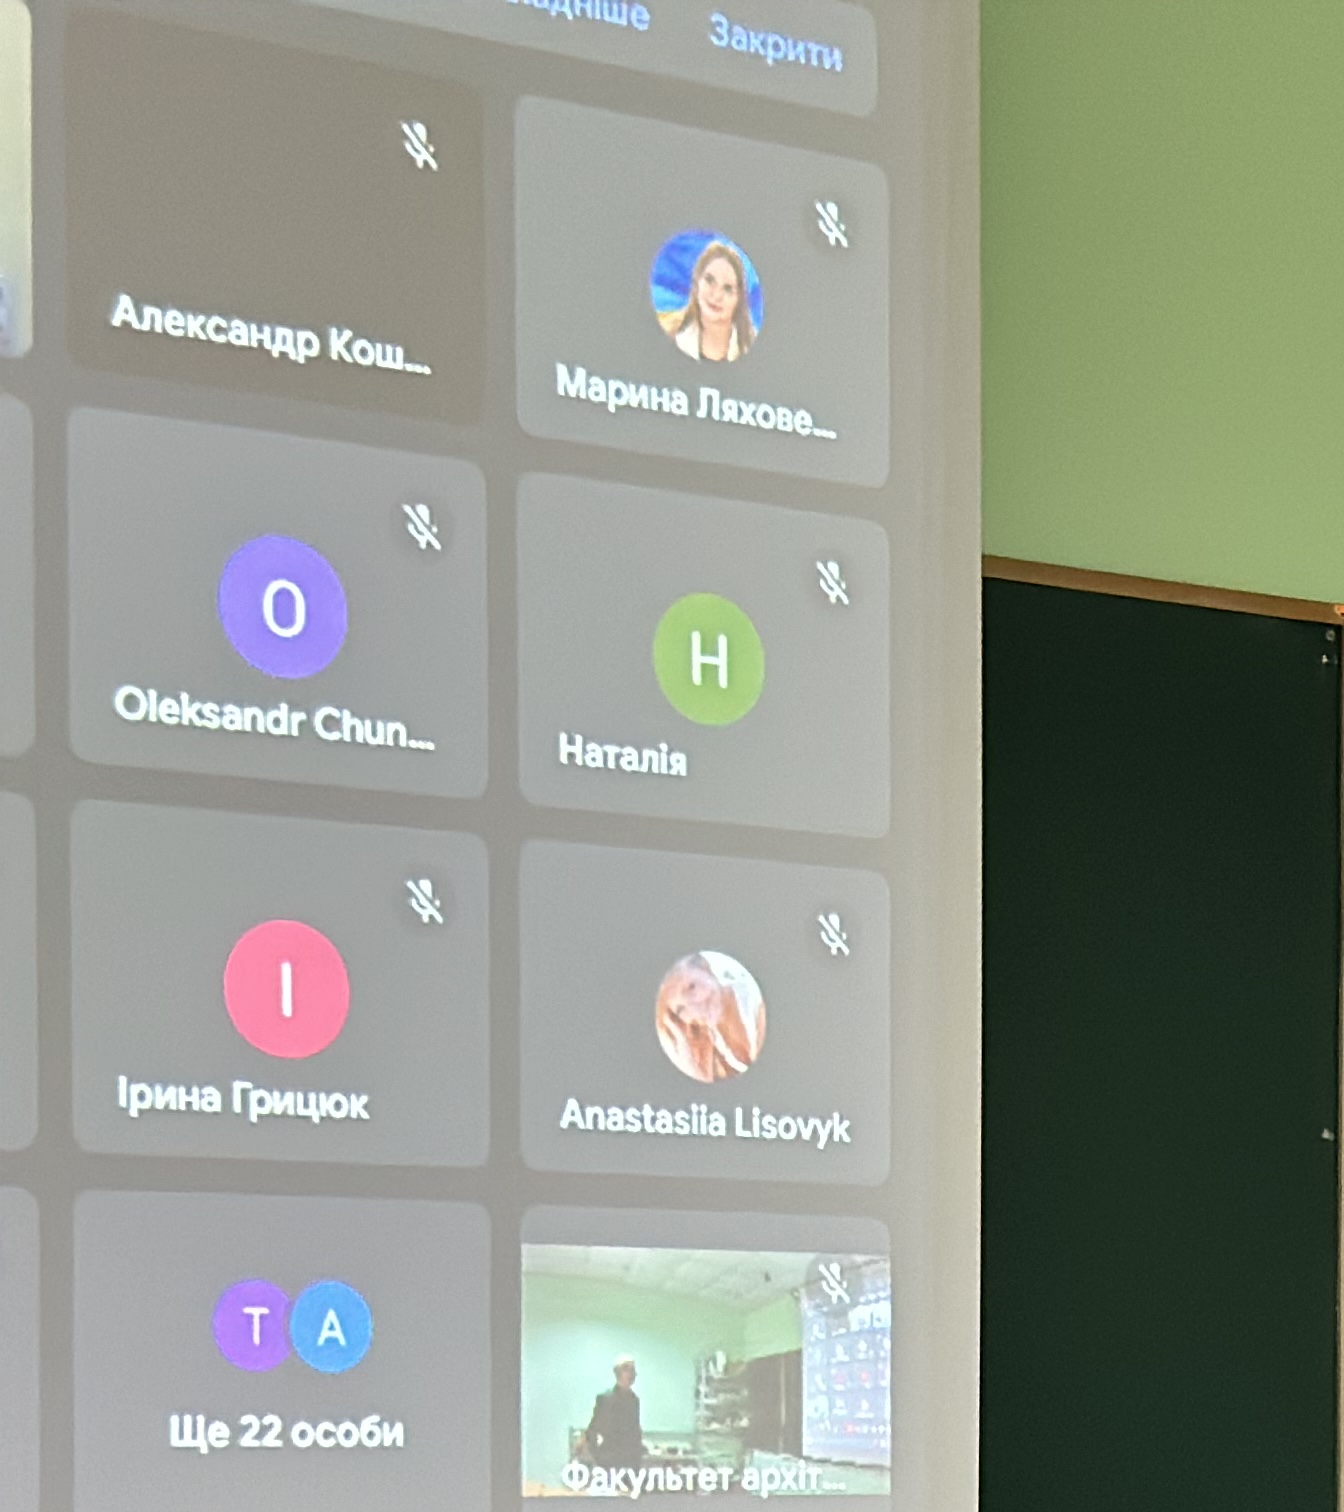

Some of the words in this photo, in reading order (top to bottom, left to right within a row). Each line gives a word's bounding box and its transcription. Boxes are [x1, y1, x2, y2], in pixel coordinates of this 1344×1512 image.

[709, 12, 844, 72] Закрити
[111, 293, 321, 364] Александр
[555, 362, 690, 413] Марина
[114, 684, 307, 737] Oleksandr
[558, 731, 688, 777] Наталія
[117, 1074, 222, 1118] Ірина
[231, 1079, 371, 1123] Грицюк
[559, 1097, 727, 1137] Anastasiia
[734, 1105, 852, 1150] Lisovyk
[169, 1413, 231, 1454] Ще
[238, 1413, 284, 1448] 22
[290, 1414, 405, 1449] особи
[561, 1460, 734, 1500] Факультет
